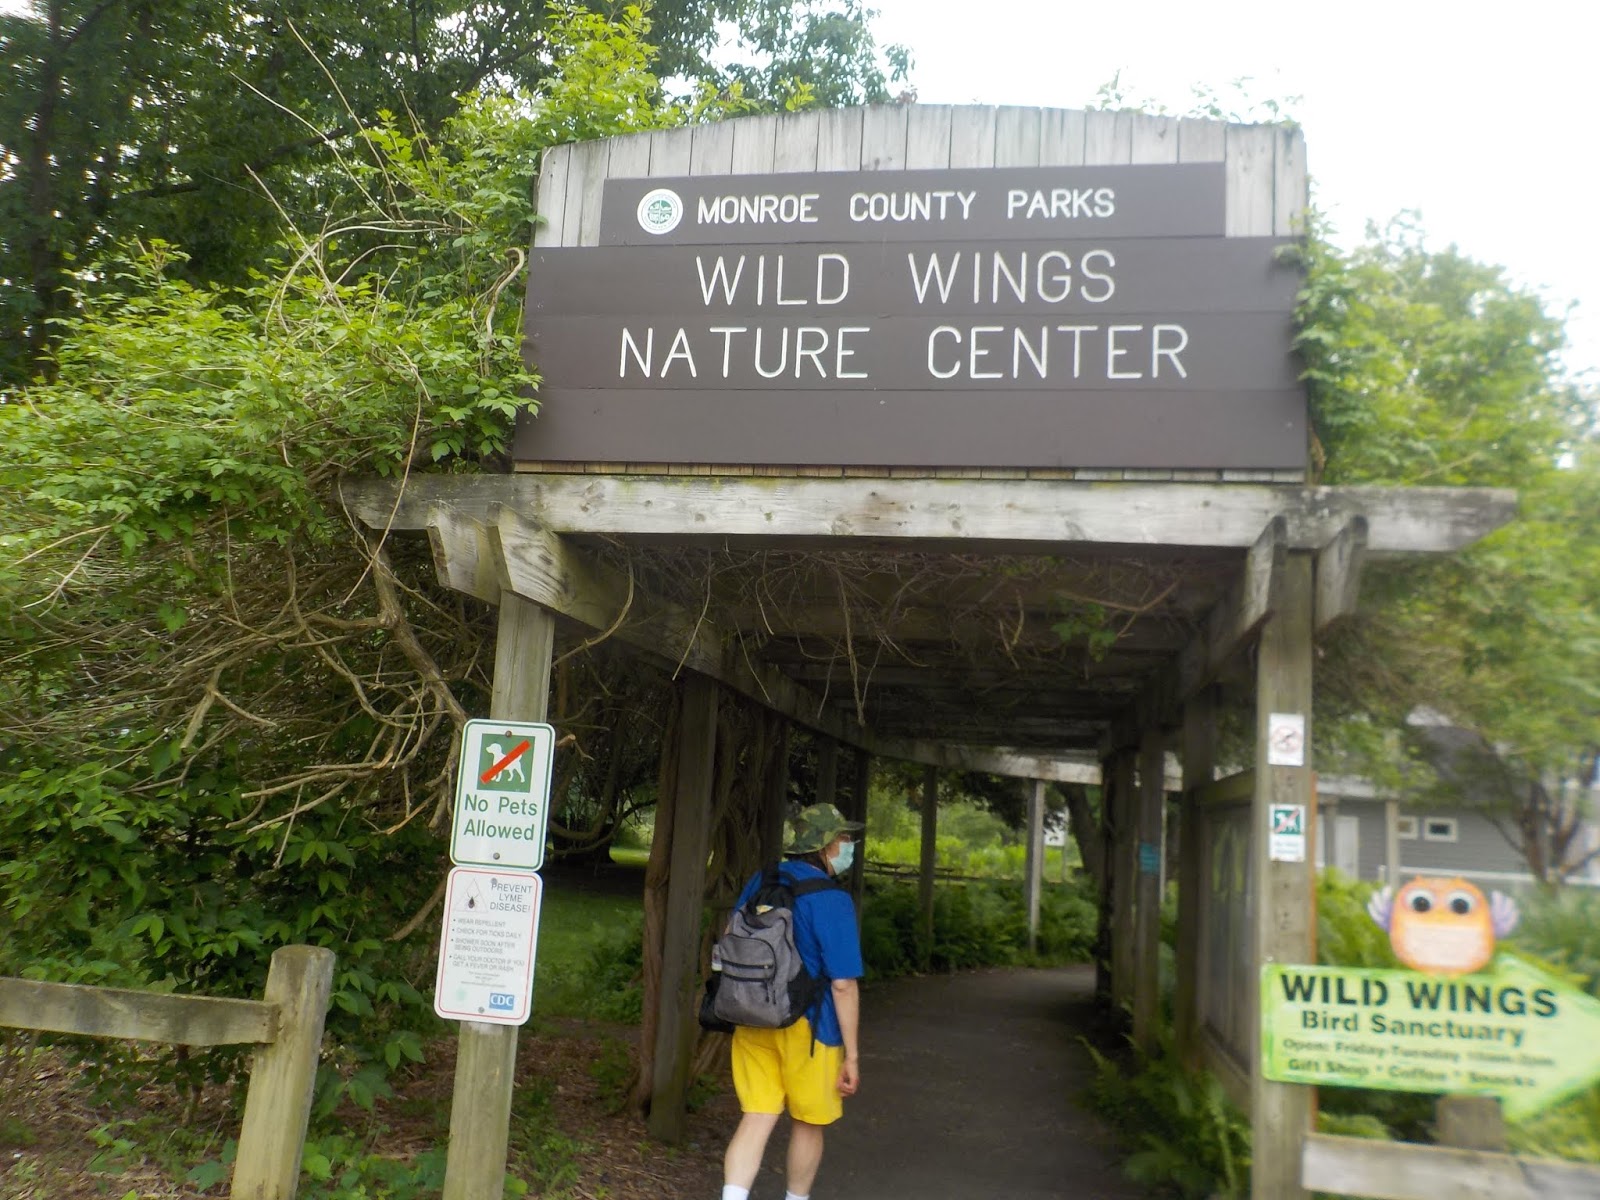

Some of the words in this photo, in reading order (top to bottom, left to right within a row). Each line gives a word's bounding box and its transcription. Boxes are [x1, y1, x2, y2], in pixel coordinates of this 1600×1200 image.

[697, 193, 820, 225] MONROE
[849, 190, 977, 222] COUNTY
[1006, 187, 1116, 220] PARKS
[695, 253, 850, 306] WILD
[907, 250, 1117, 305] WINGS
[619, 326, 871, 379] NATURE
[927, 324, 1189, 379] CENTER
[464, 793, 489, 812] No
[498, 796, 538, 816] Pets
[463, 819, 535, 841] Allowed
[491, 883, 533, 894] PREVENT
[499, 893, 523, 903] LYME
[490, 901, 531, 913] DISEASE!
[456, 927, 475, 935] CHECK
[490, 994, 514, 1007] CDC
[1281, 974, 1389, 1007] WILD
[1405, 980, 1559, 1019] WINGS
[1302, 1010, 1359, 1032] Bird
[1371, 1014, 1525, 1047] Sanctuary
[1288, 1058, 1320, 1072] Gift
